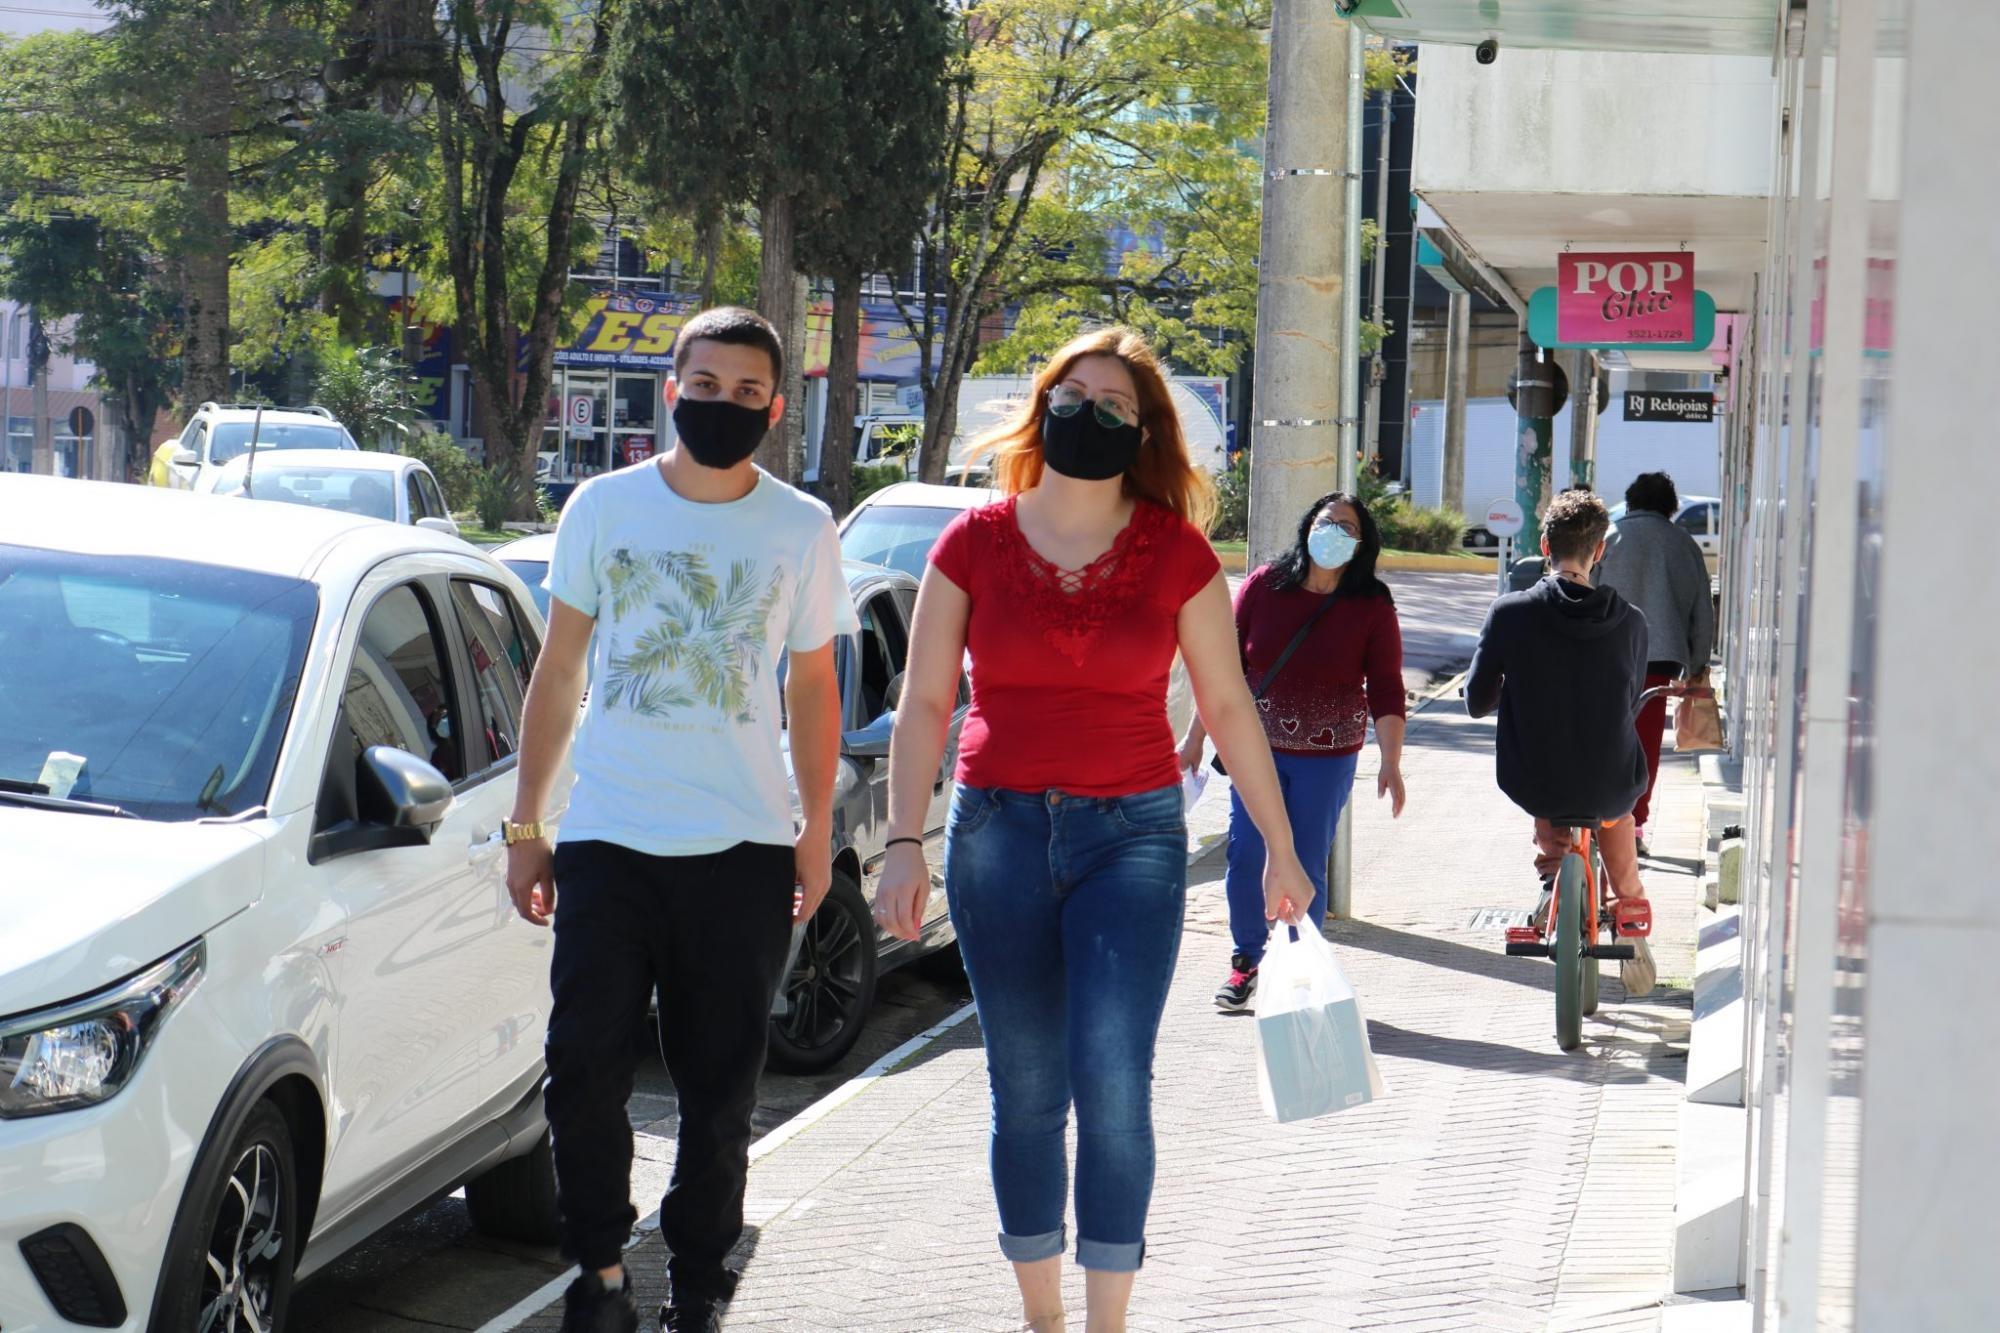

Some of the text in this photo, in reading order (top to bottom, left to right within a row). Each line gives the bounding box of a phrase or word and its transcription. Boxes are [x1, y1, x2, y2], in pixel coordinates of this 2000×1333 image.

[1572, 261, 1683, 294] POP
[1602, 290, 1676, 321] Chic
[1627, 329, 1683, 338] 3521-1729
[578, 403, 585, 418] E
[1650, 397, 1708, 416] Relojoias
